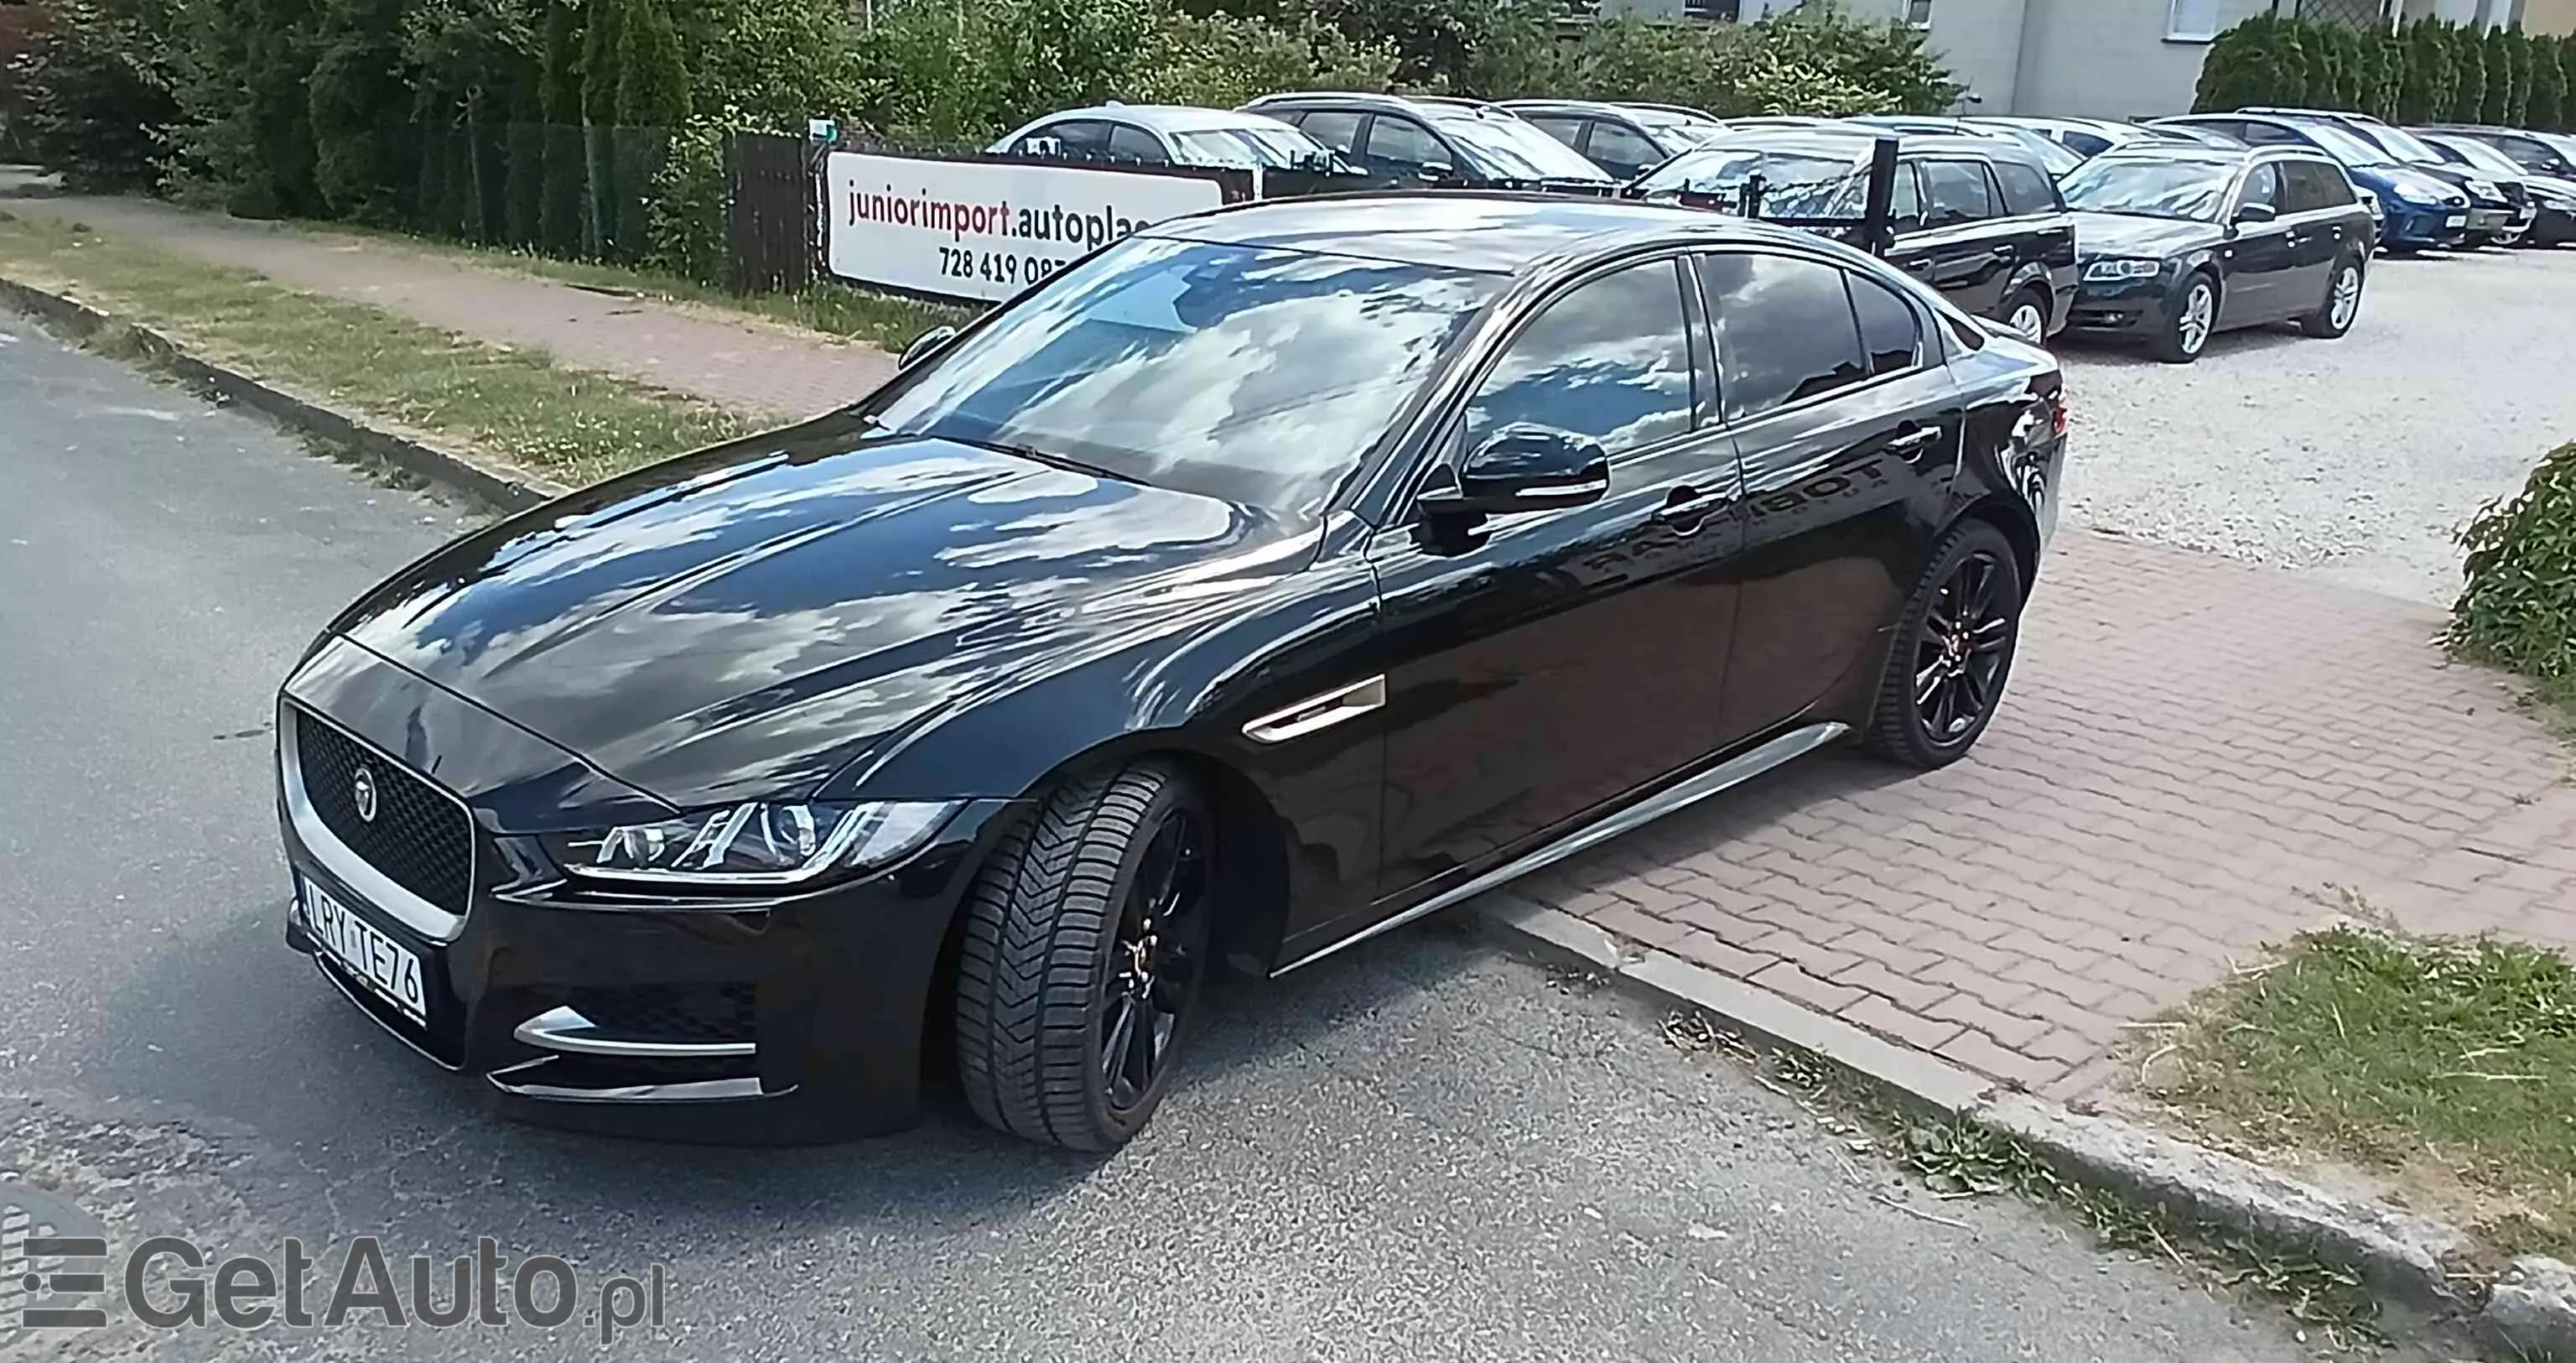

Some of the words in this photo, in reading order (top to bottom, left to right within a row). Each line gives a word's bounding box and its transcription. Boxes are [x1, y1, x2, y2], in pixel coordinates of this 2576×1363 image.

[939, 247, 973, 278] 728
[979, 252, 1017, 284] 419
[1024, 257, 1066, 285] 08
[309, 884, 345, 955] LRY
[355, 920, 418, 1004] TE76
